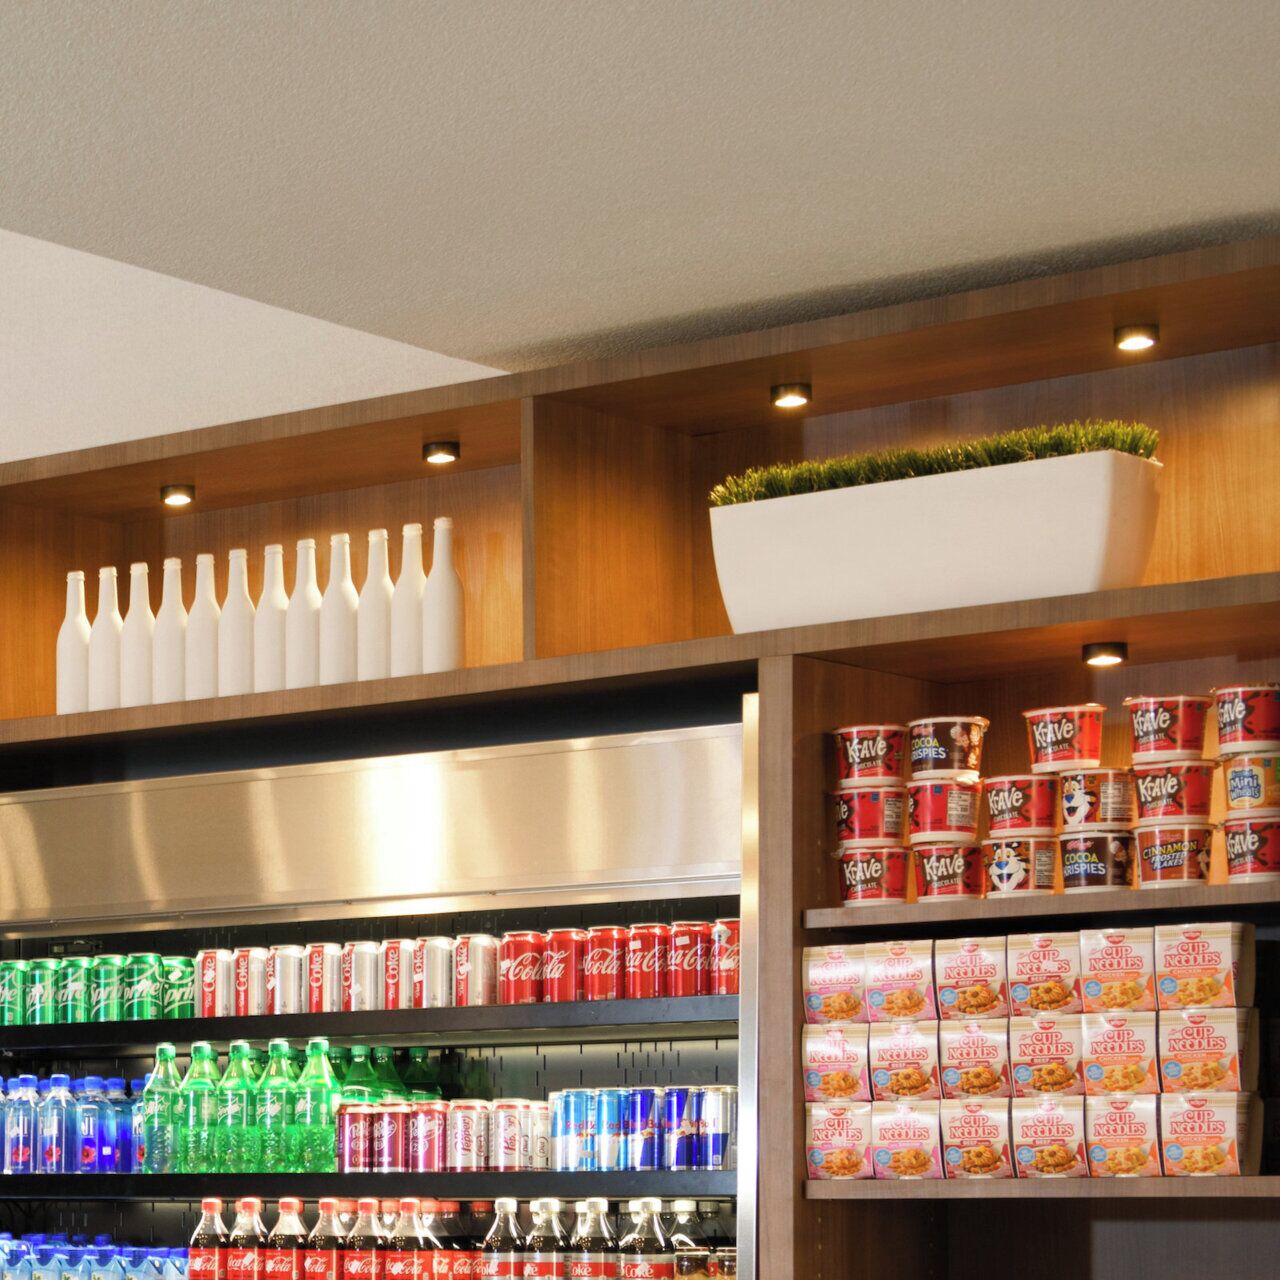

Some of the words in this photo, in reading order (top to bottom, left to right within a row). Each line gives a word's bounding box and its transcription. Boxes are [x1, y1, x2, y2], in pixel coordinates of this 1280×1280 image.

[912, 738, 940, 750] COCOA
[912, 748, 947, 762] RISPIES
[1230, 777, 1259, 788] Mini
[1064, 851, 1099, 864] COCOA
[1143, 841, 1198, 860] CINNAMON
[1152, 859, 1184, 870] FLAKES
[1102, 946, 1133, 959] CUP
[1177, 942, 1210, 954] CUP
[956, 955, 985, 967] CUP
[1029, 950, 1060, 963] CUP
[1163, 952, 1222, 969] NOODLES
[309, 950, 323, 986] Coke
[386, 947, 399, 983] Coke
[1088, 957, 1144, 972] NOODLES
[236, 954, 249, 991] Coke
[944, 965, 997, 980] NOODLES
[1031, 1032, 1062, 1045] CUP
[1103, 1029, 1135, 1042] CUP
[1181, 1025, 1215, 1039] CUP
[959, 1036, 989, 1049] CUP
[1090, 1040, 1146, 1055] NOODLES
[1168, 1037, 1227, 1052] NOODLES
[877, 1049, 929, 1062] NOODLES
[947, 1047, 999, 1061] NOODLES
[1019, 1042, 1074, 1058] NOODLES
[960, 1115, 989, 1127] CUP
[1032, 1114, 1064, 1126] CUP
[1105, 1112, 1136, 1124] CUP
[1182, 1109, 1215, 1123] CUP
[824, 1118, 852, 1130] CUP
[1093, 1122, 1147, 1137] NOODLES
[1170, 1120, 1227, 1136] NOODLES
[879, 1127, 930, 1141] NOODLES
[949, 1126, 1000, 1140] NOODLES
[1021, 1124, 1075, 1139] NOODLES
